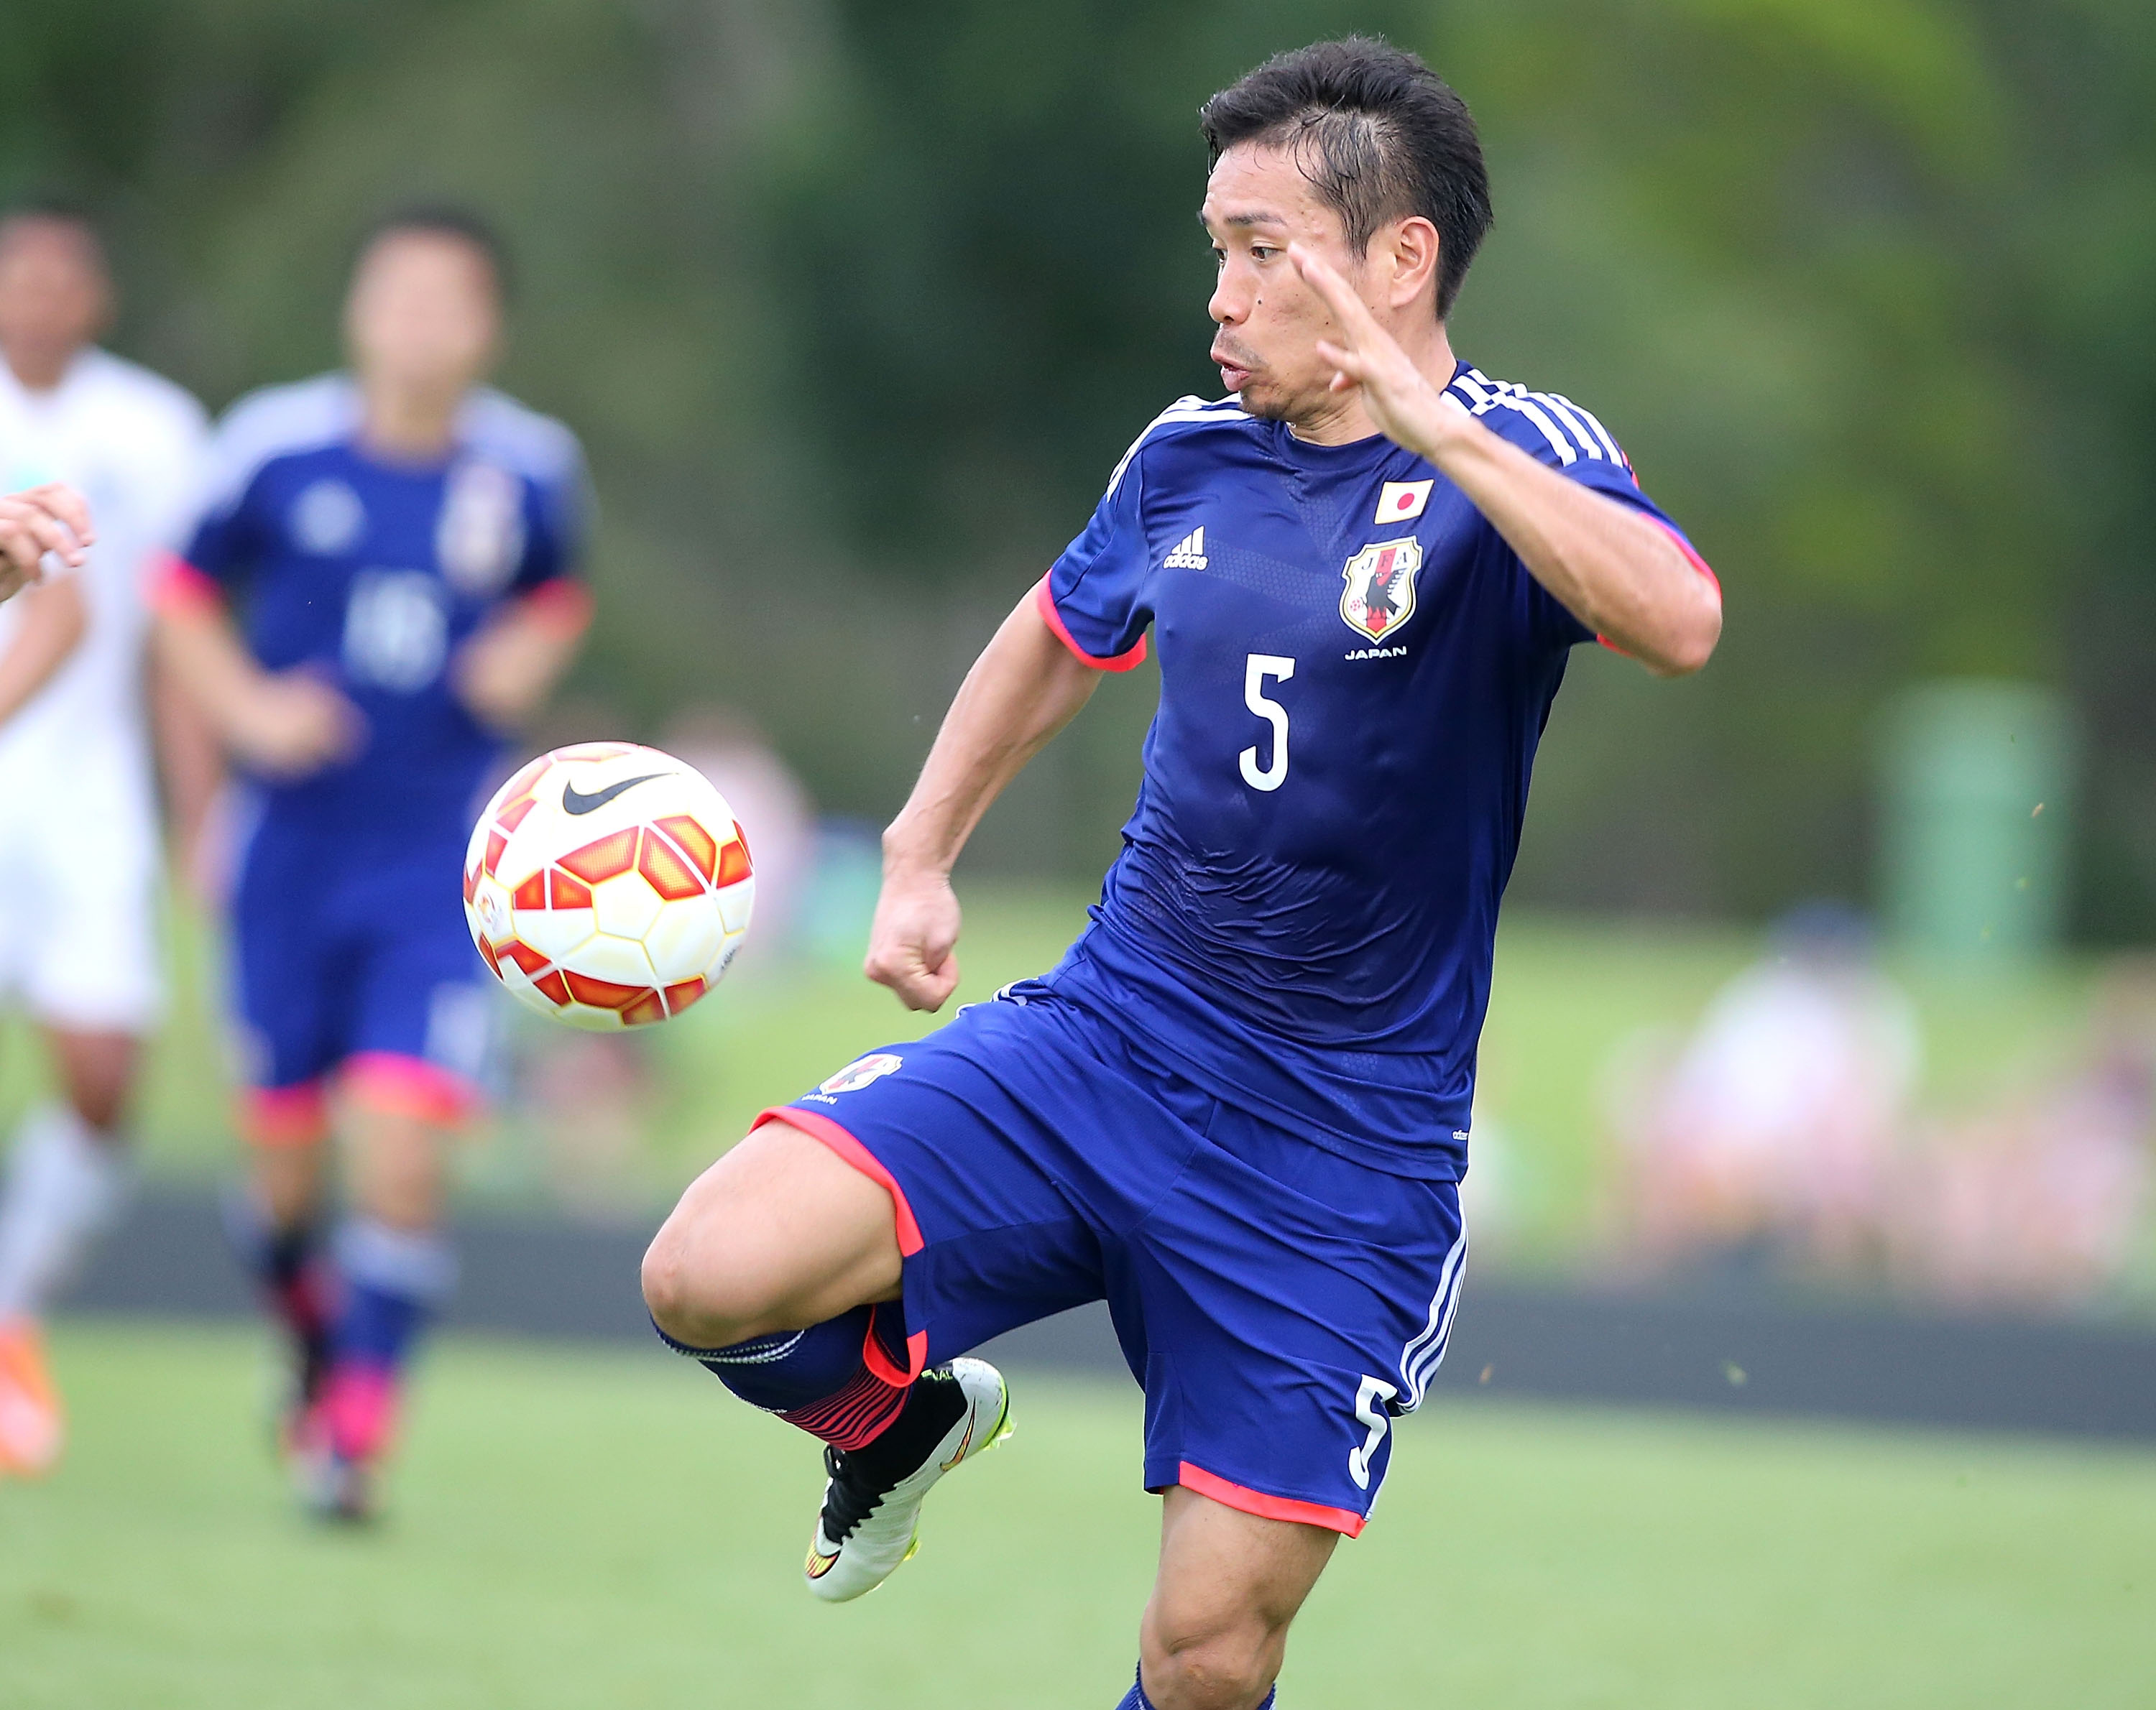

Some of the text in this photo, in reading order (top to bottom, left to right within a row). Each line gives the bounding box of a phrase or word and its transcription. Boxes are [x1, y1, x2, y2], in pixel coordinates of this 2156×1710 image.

[1163, 551, 1209, 570] adidas
[1361, 551, 1408, 570] JFA
[1345, 645, 1408, 661] JAPAN
[1239, 652, 1296, 792] 5
[1348, 1373, 1399, 1491] 5
